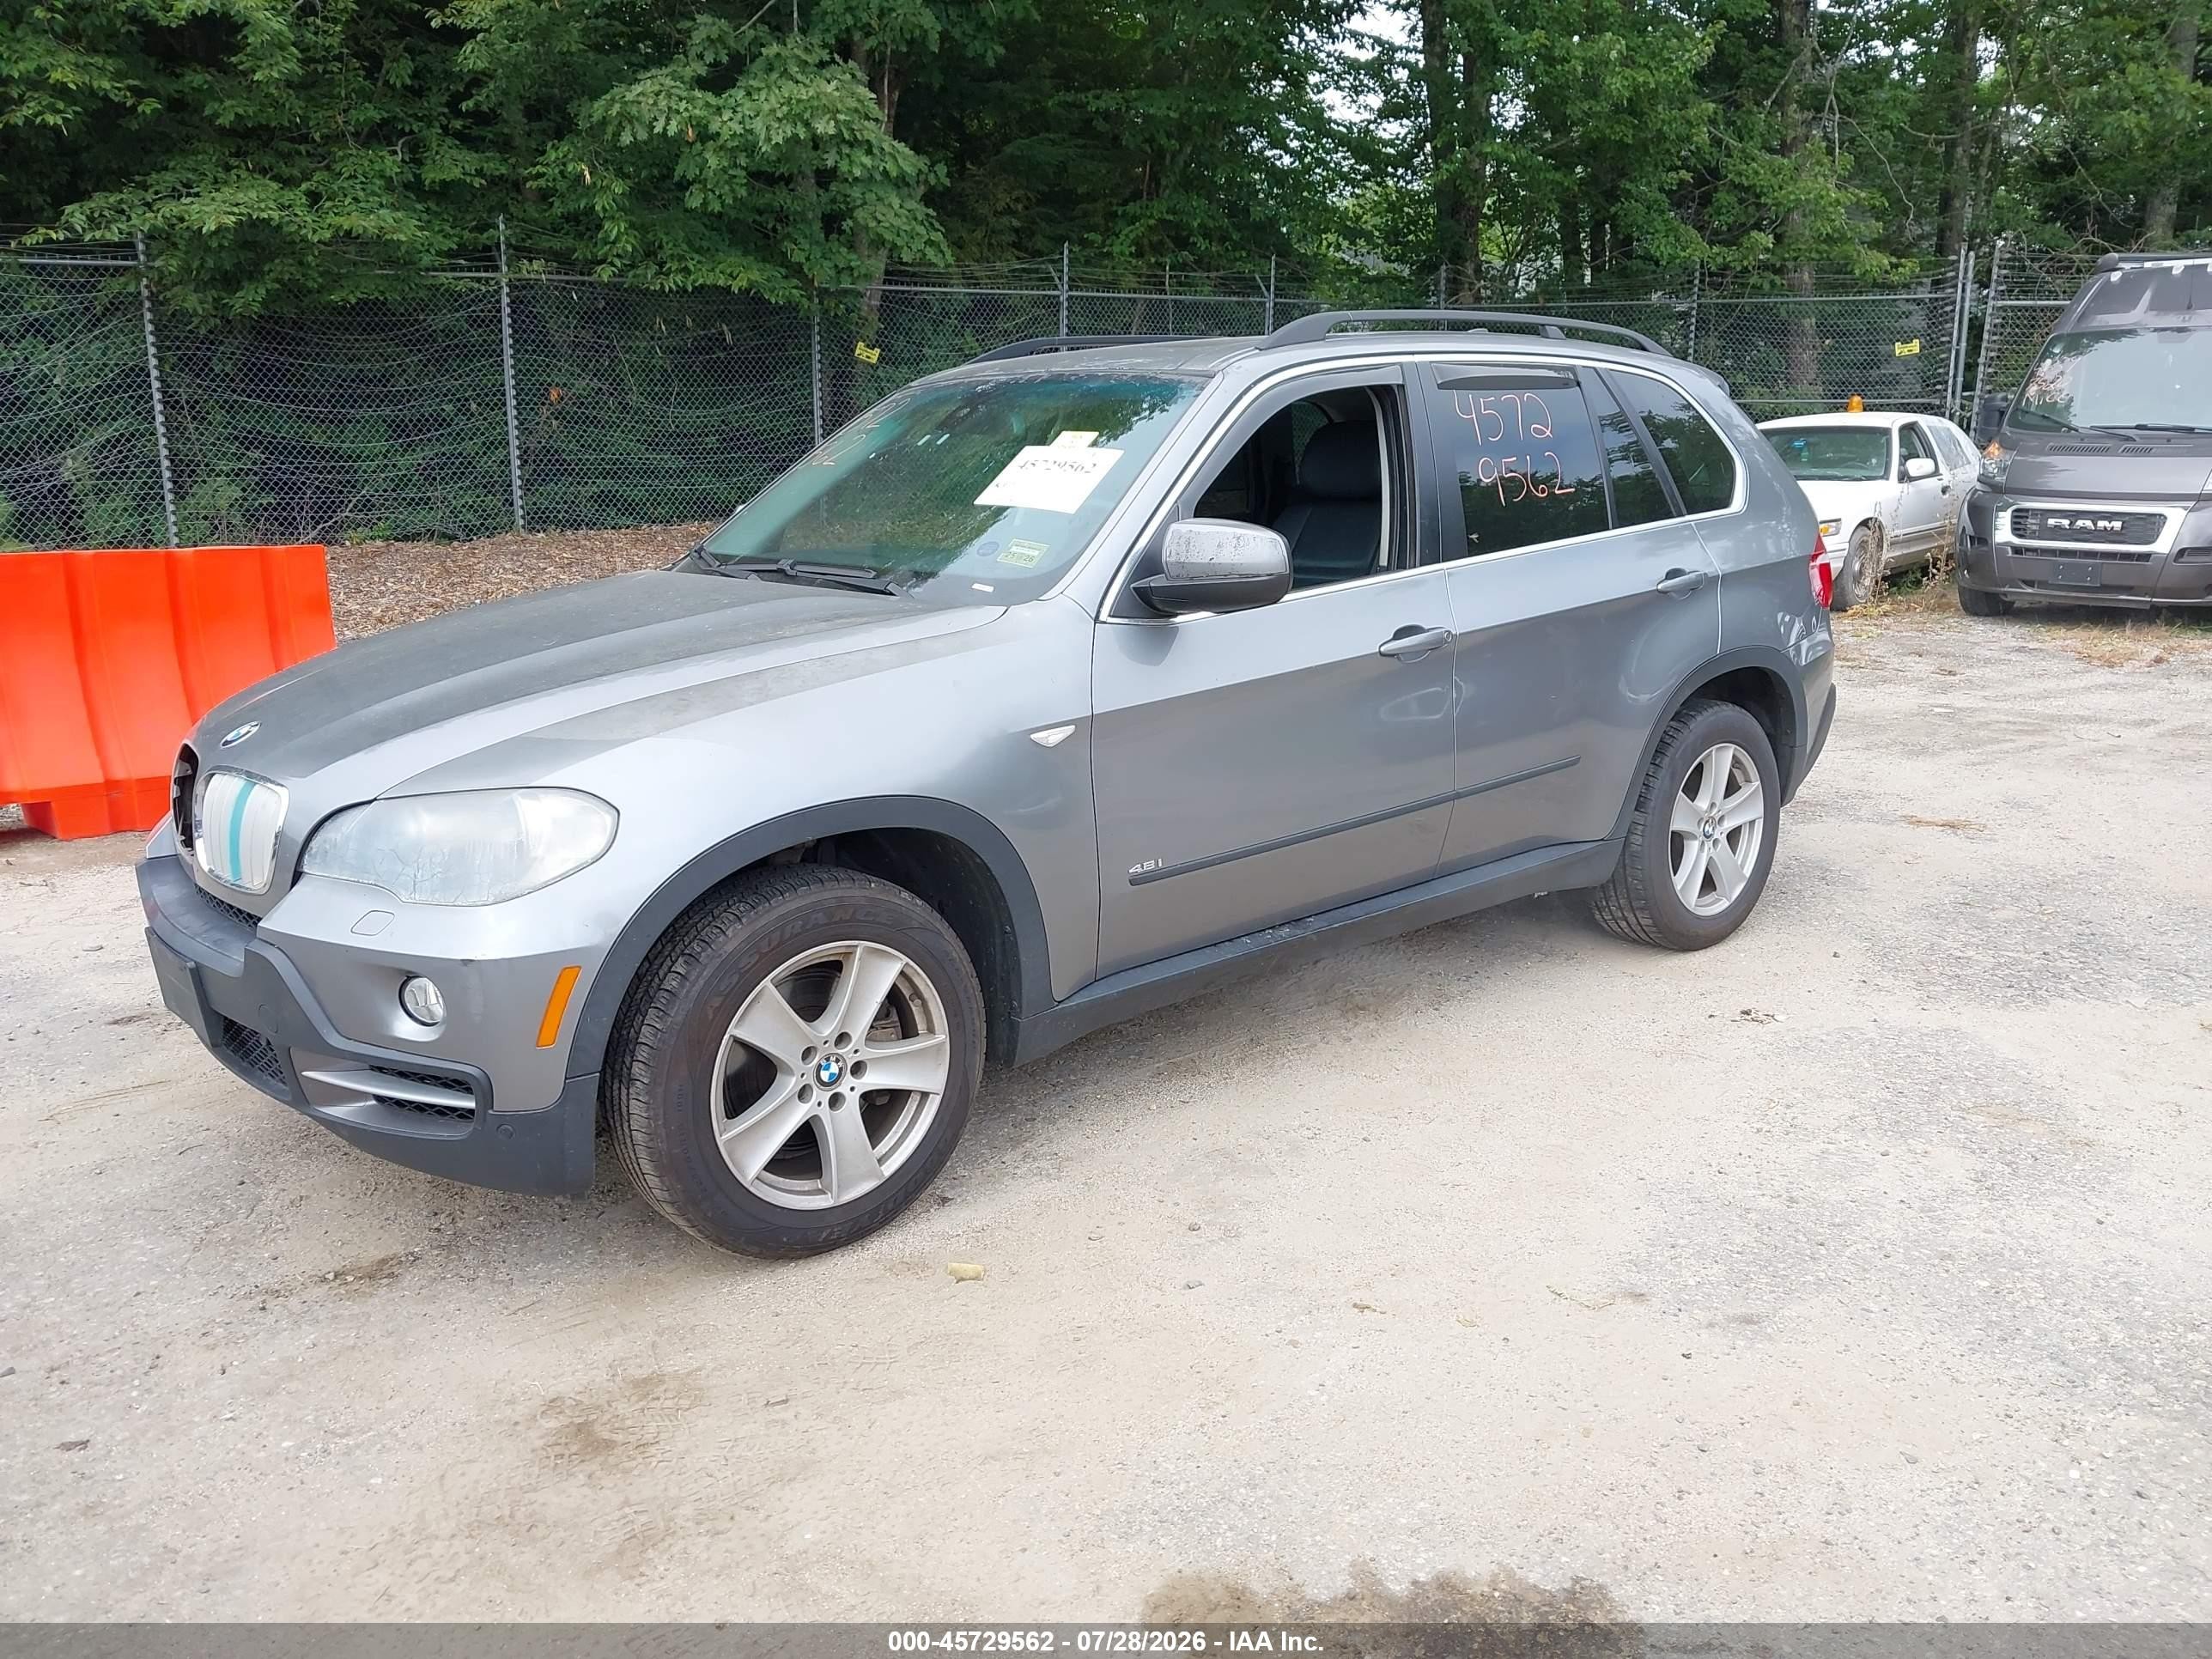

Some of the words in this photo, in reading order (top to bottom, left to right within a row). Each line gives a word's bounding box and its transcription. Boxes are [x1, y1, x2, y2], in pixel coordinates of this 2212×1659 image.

[1453, 390, 1553, 446] 4572
[1478, 452, 1576, 507] 9562
[2047, 518, 2124, 532] RAM
